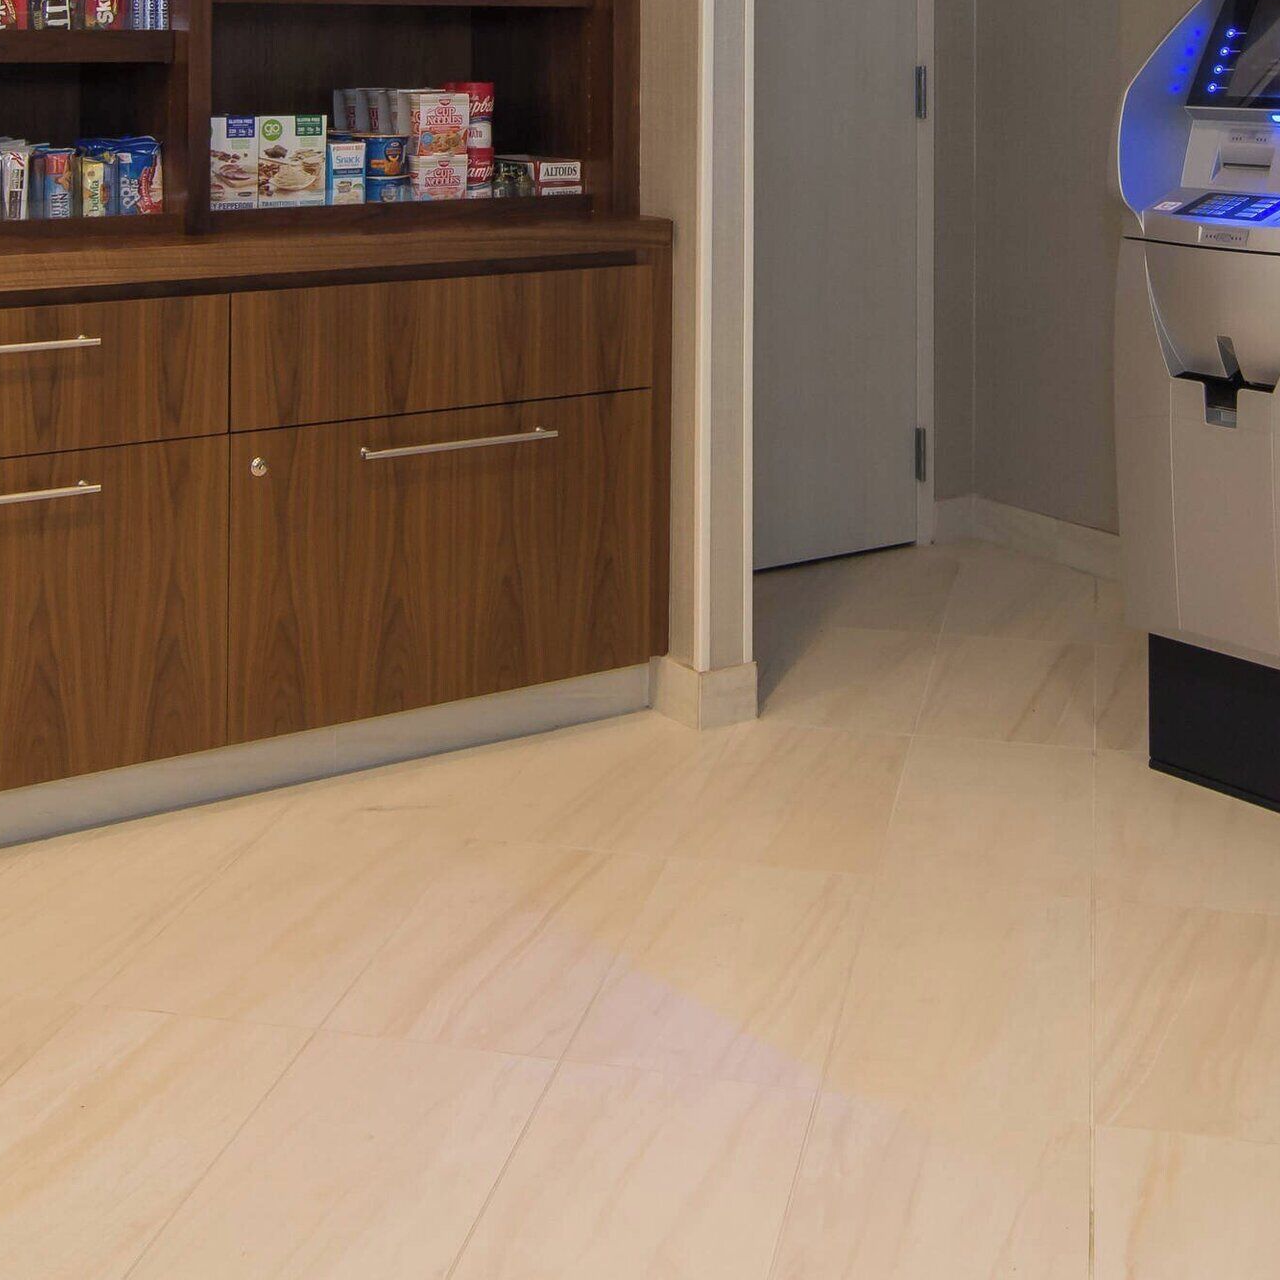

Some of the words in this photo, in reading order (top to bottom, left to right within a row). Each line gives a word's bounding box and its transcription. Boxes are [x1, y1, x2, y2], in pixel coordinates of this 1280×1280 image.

[433, 106, 457, 117] CUP
[426, 114, 463, 126] NOODLES
[336, 155, 361, 165] Snack
[432, 167, 455, 179] CUP
[544, 166, 578, 177] ALTOIDS
